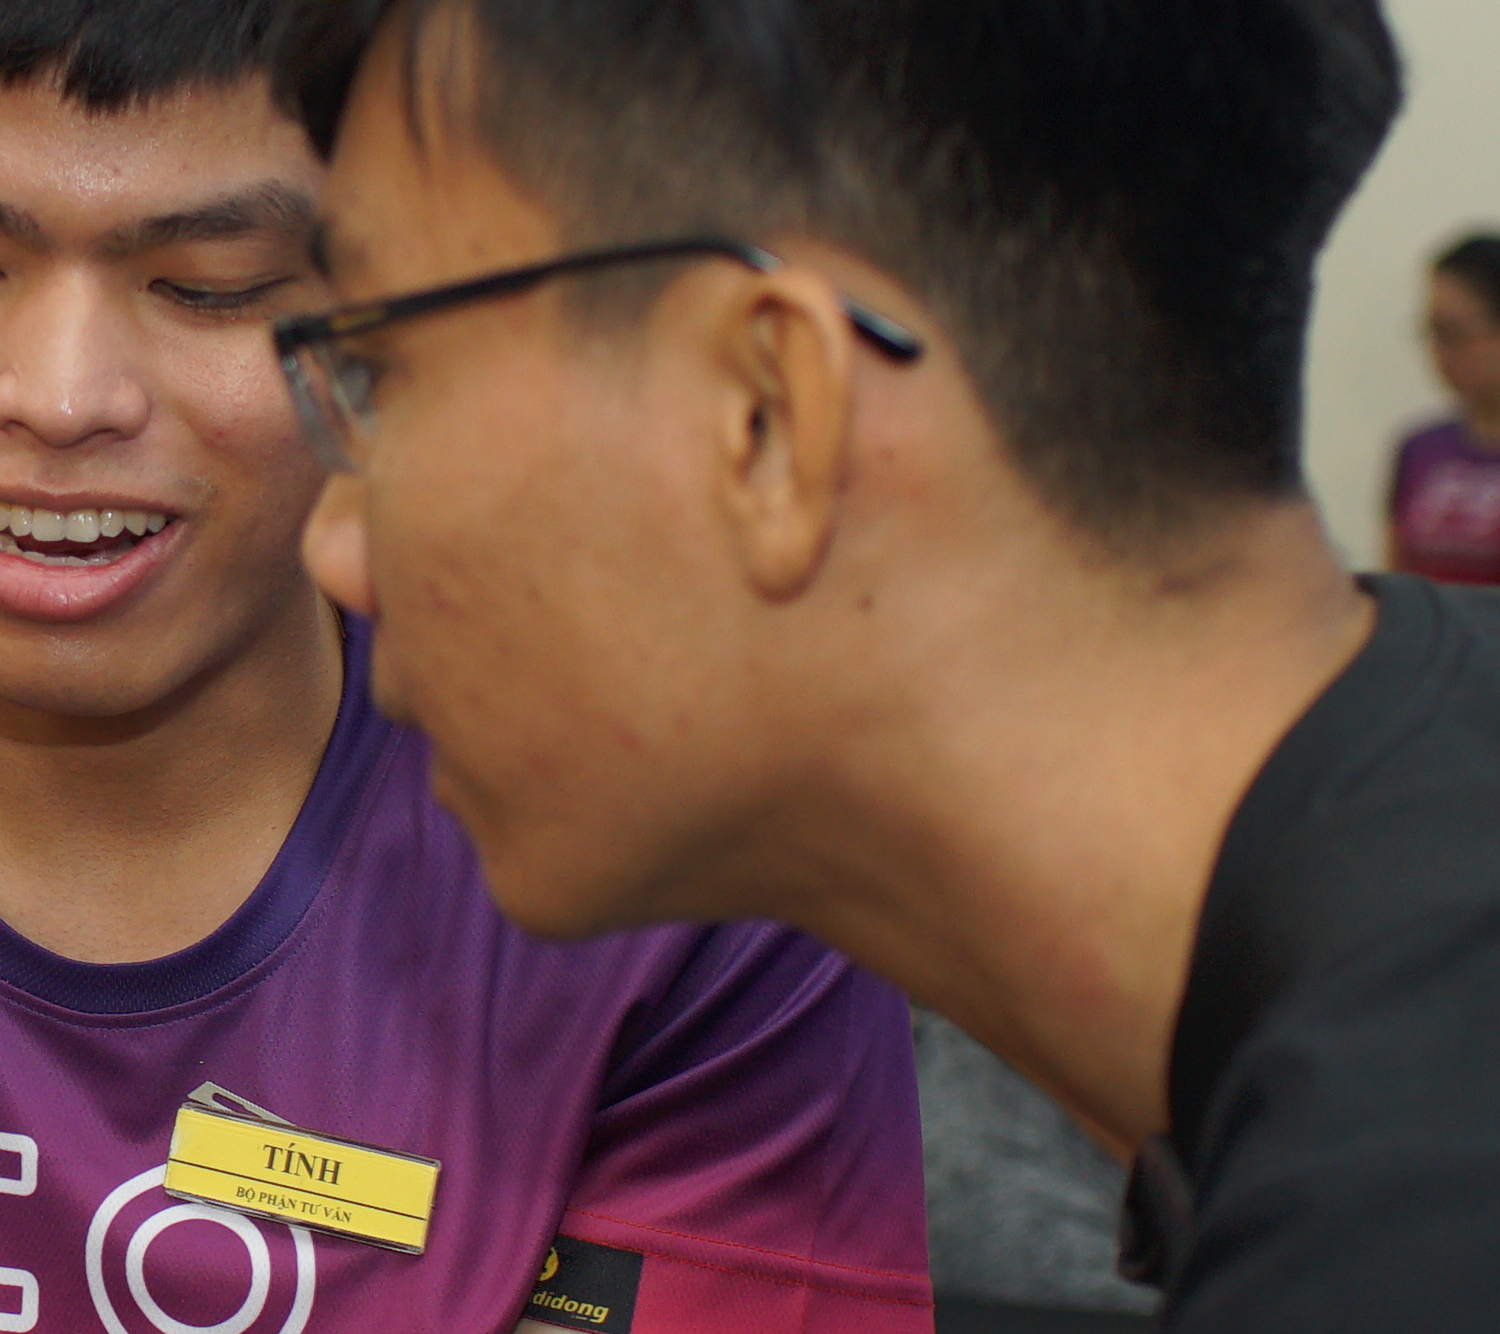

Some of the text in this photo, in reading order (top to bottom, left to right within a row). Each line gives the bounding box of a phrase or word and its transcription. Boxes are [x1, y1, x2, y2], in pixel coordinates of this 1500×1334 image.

[262, 1142, 344, 1186] TÍNH
[235, 1186, 255, 1204] BỘ
[258, 1189, 298, 1211] PHẬN
[300, 1201, 323, 1215] TƯ
